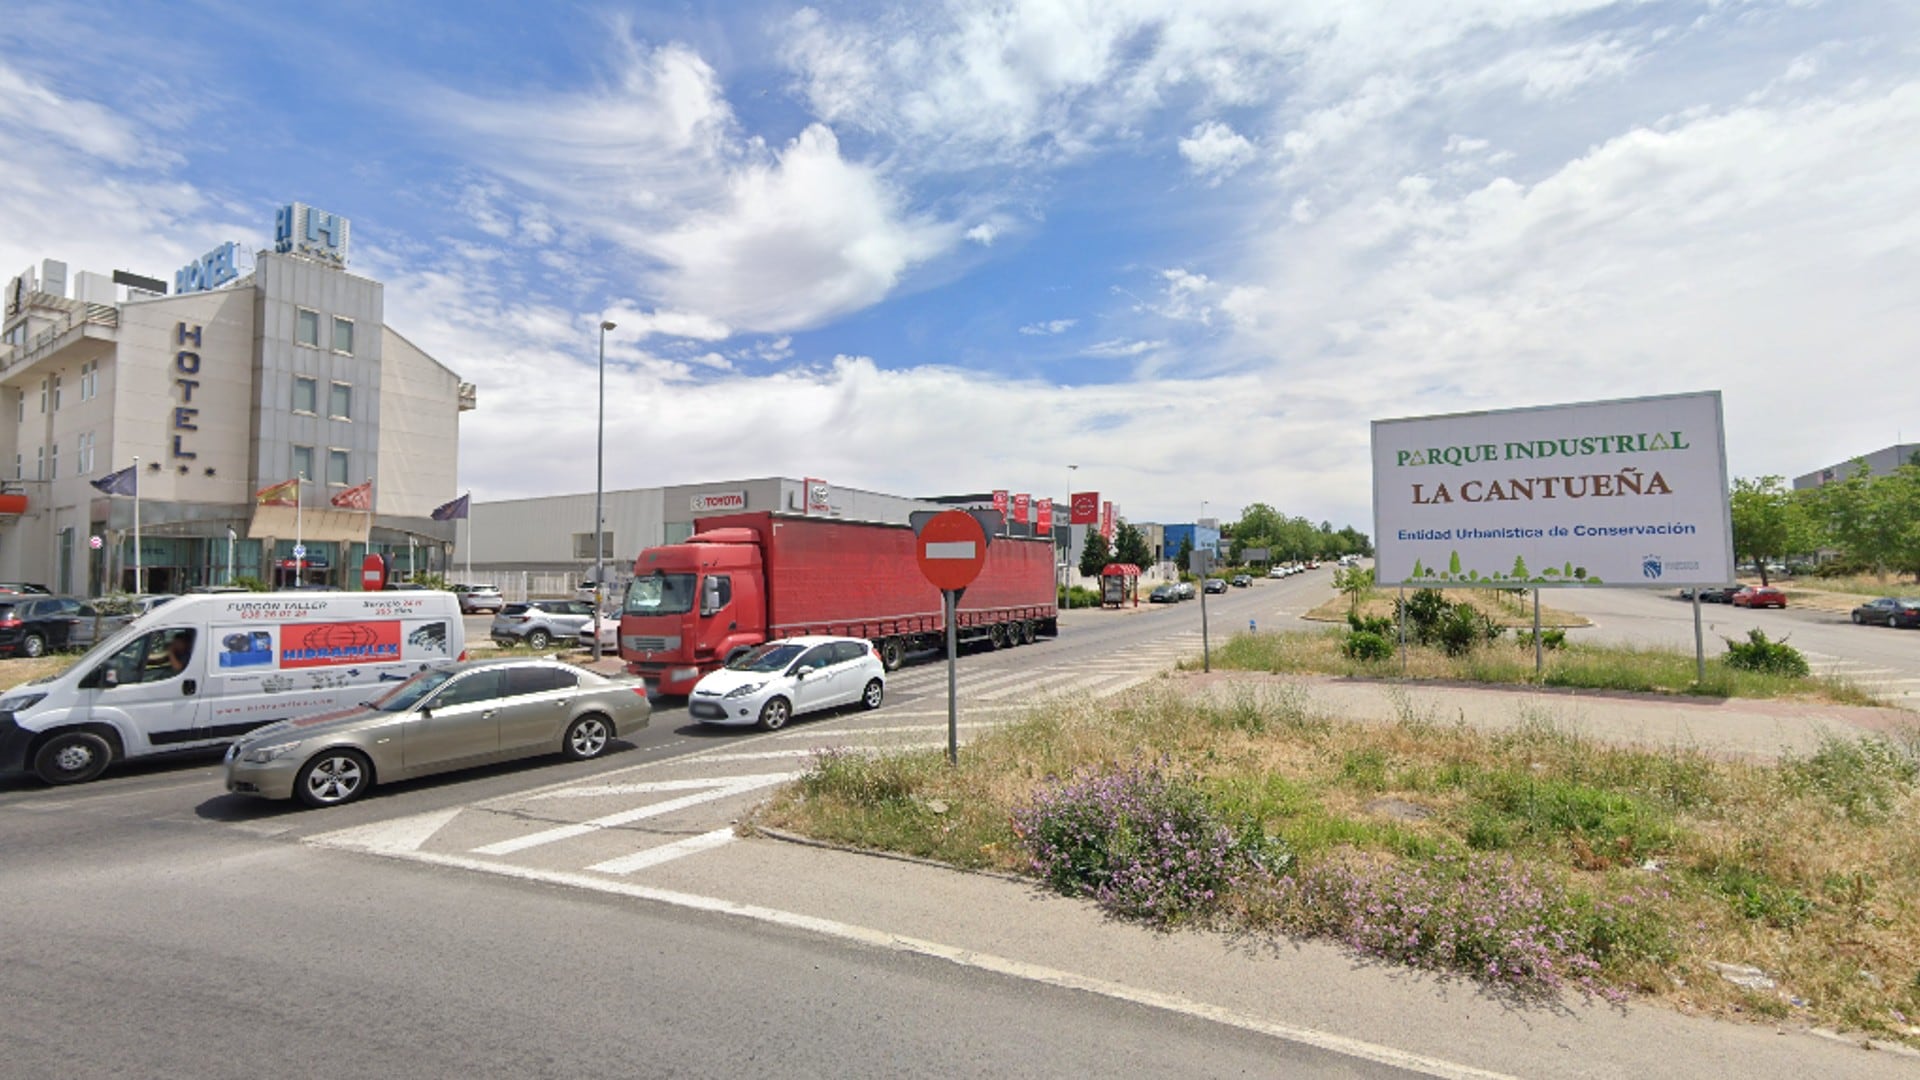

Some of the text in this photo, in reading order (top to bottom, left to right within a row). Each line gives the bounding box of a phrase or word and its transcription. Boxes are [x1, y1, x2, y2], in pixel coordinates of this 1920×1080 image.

[175, 241, 238, 294] HOTEL
[173, 322, 202, 459] HOTEL
[1397, 431, 1690, 467] PARQUE INDUSTRIAL
[705, 495, 743, 507] TOYOTA
[1411, 467, 1673, 505] LA CANTUEÑA
[1398, 528, 1451, 541] Entidad
[1548, 525, 1569, 537] de
[1573, 521, 1696, 537] Conservación
[283, 644, 398, 660] HIDRAMFLEX
